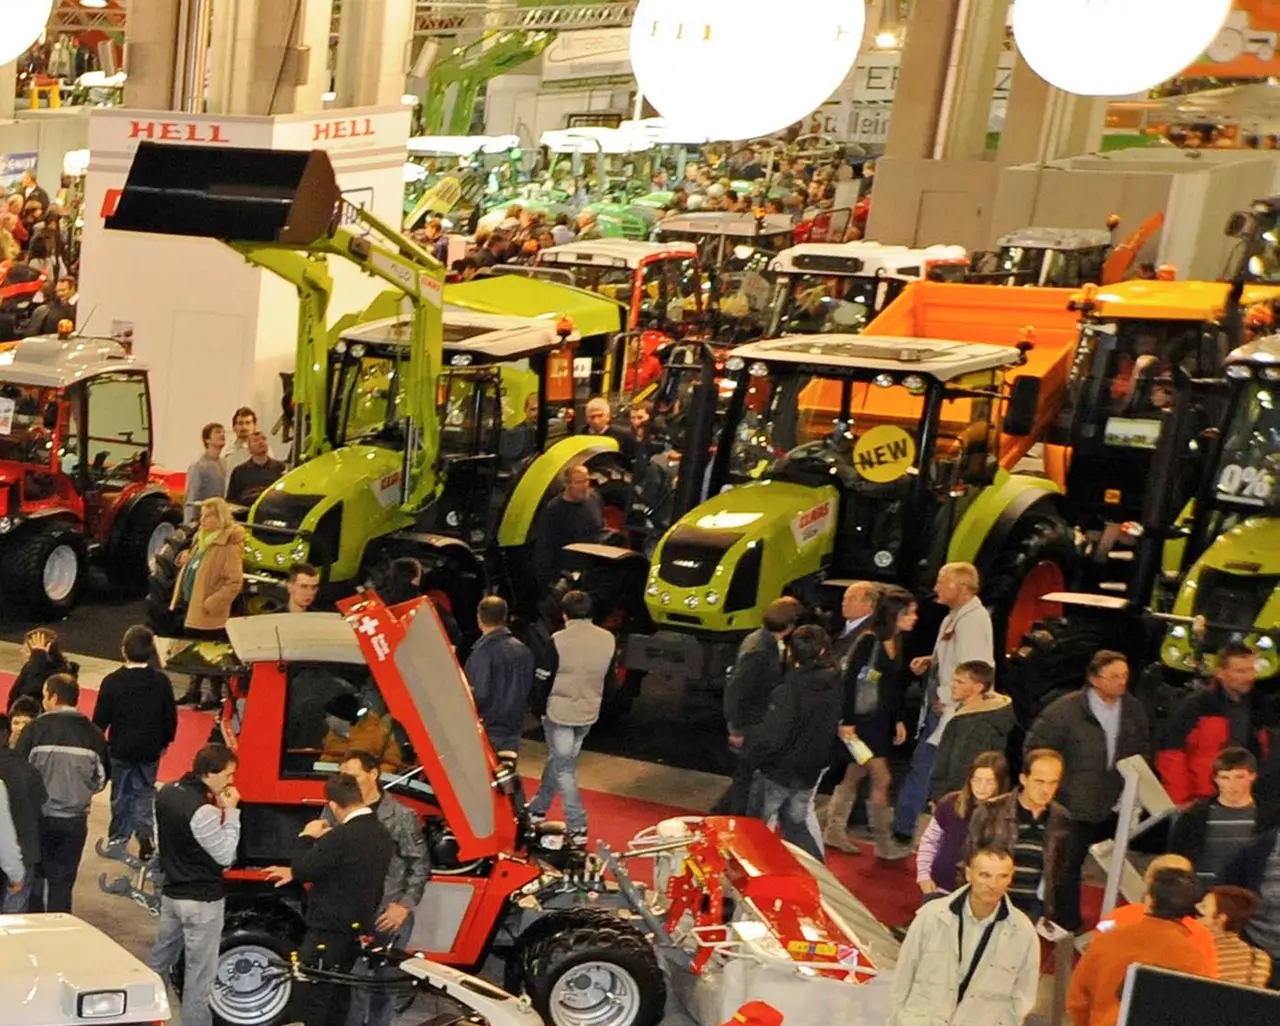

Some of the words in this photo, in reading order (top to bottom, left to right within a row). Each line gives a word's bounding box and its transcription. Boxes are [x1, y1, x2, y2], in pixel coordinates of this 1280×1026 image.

[129, 120, 230, 143] HELL
[312, 118, 376, 141] HELL
[857, 438, 909, 471] NEW
[1216, 463, 1273, 499] 0%
